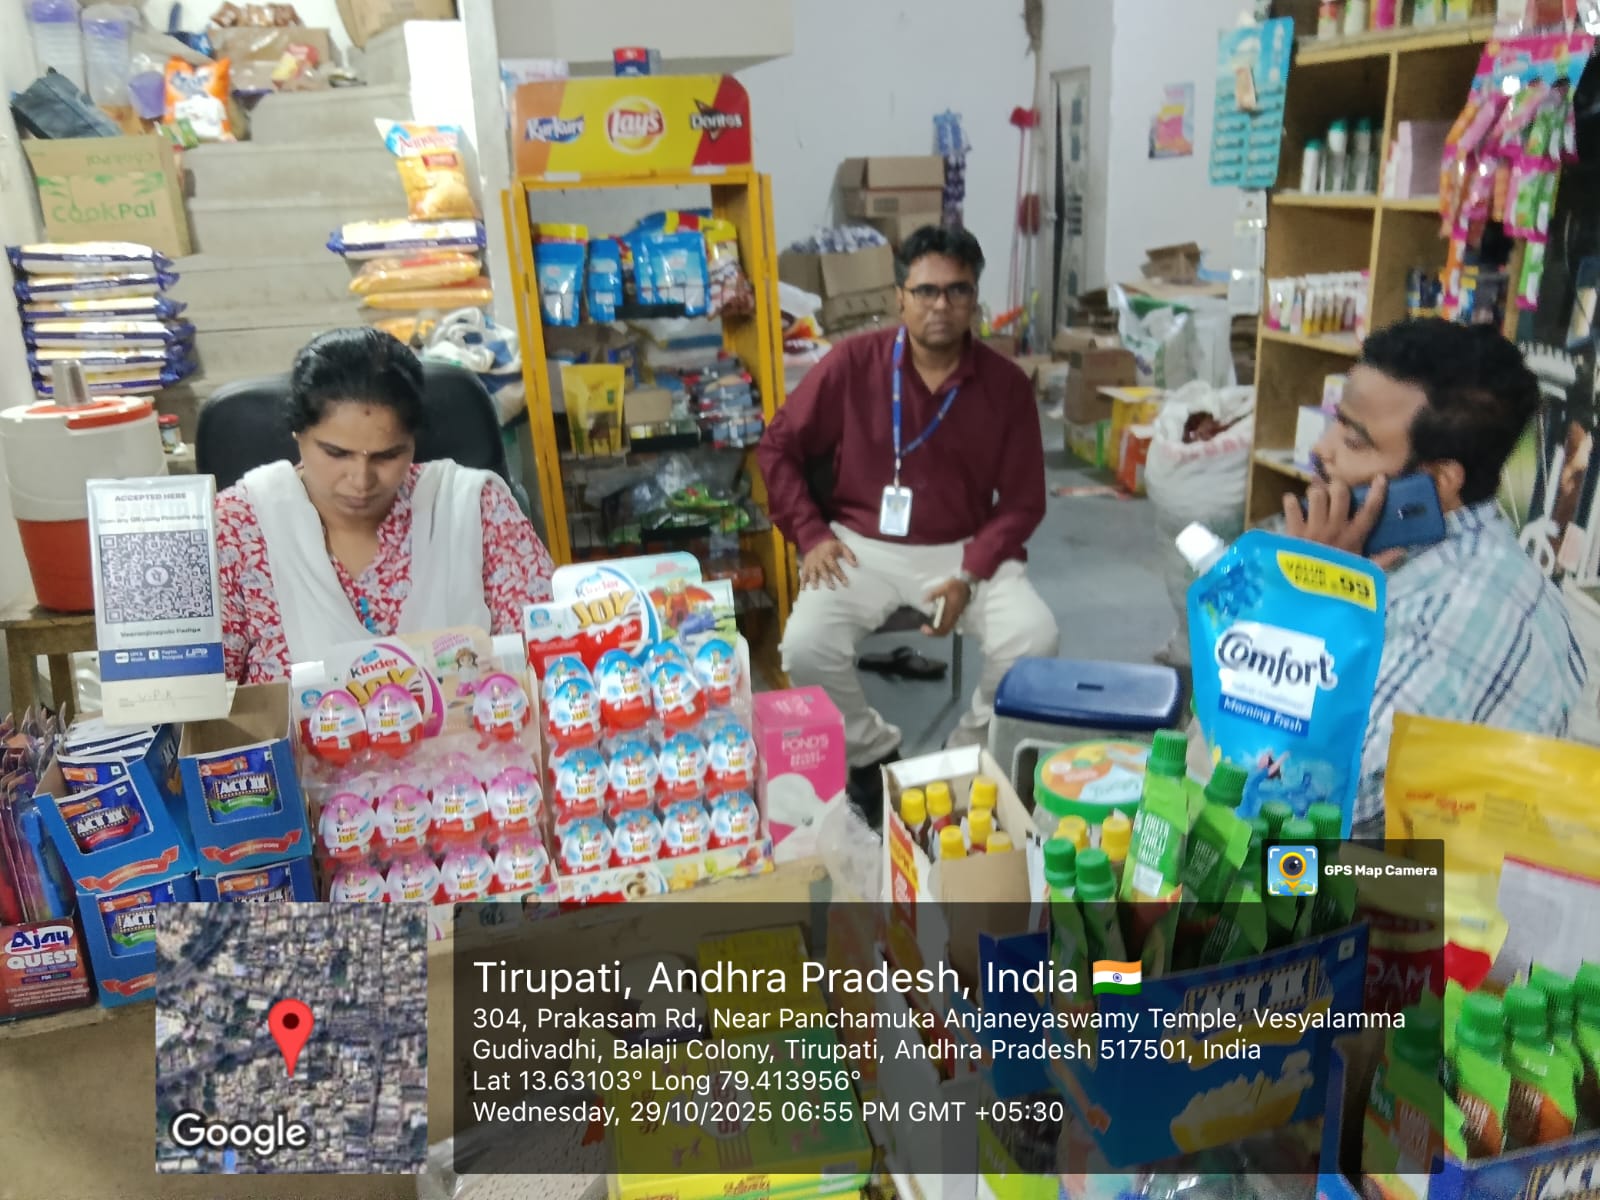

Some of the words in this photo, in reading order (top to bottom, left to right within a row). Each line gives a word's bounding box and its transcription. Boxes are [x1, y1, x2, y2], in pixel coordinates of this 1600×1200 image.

[691, 113, 743, 131] Doritos
[115, 494, 163, 502] ACCEPTED
[163, 492, 187, 500] HERE
[571, 591, 636, 629] JOY
[350, 656, 399, 678] Kinder
[1218, 631, 1334, 688] Comfort
[1223, 696, 1271, 725] Morning
[1273, 713, 1303, 734] Fresh
[220, 779, 248, 794] ACT
[76, 812, 106, 834] ACT
[11, 928, 70, 950] Ajay
[6, 949, 78, 970] QUEST
